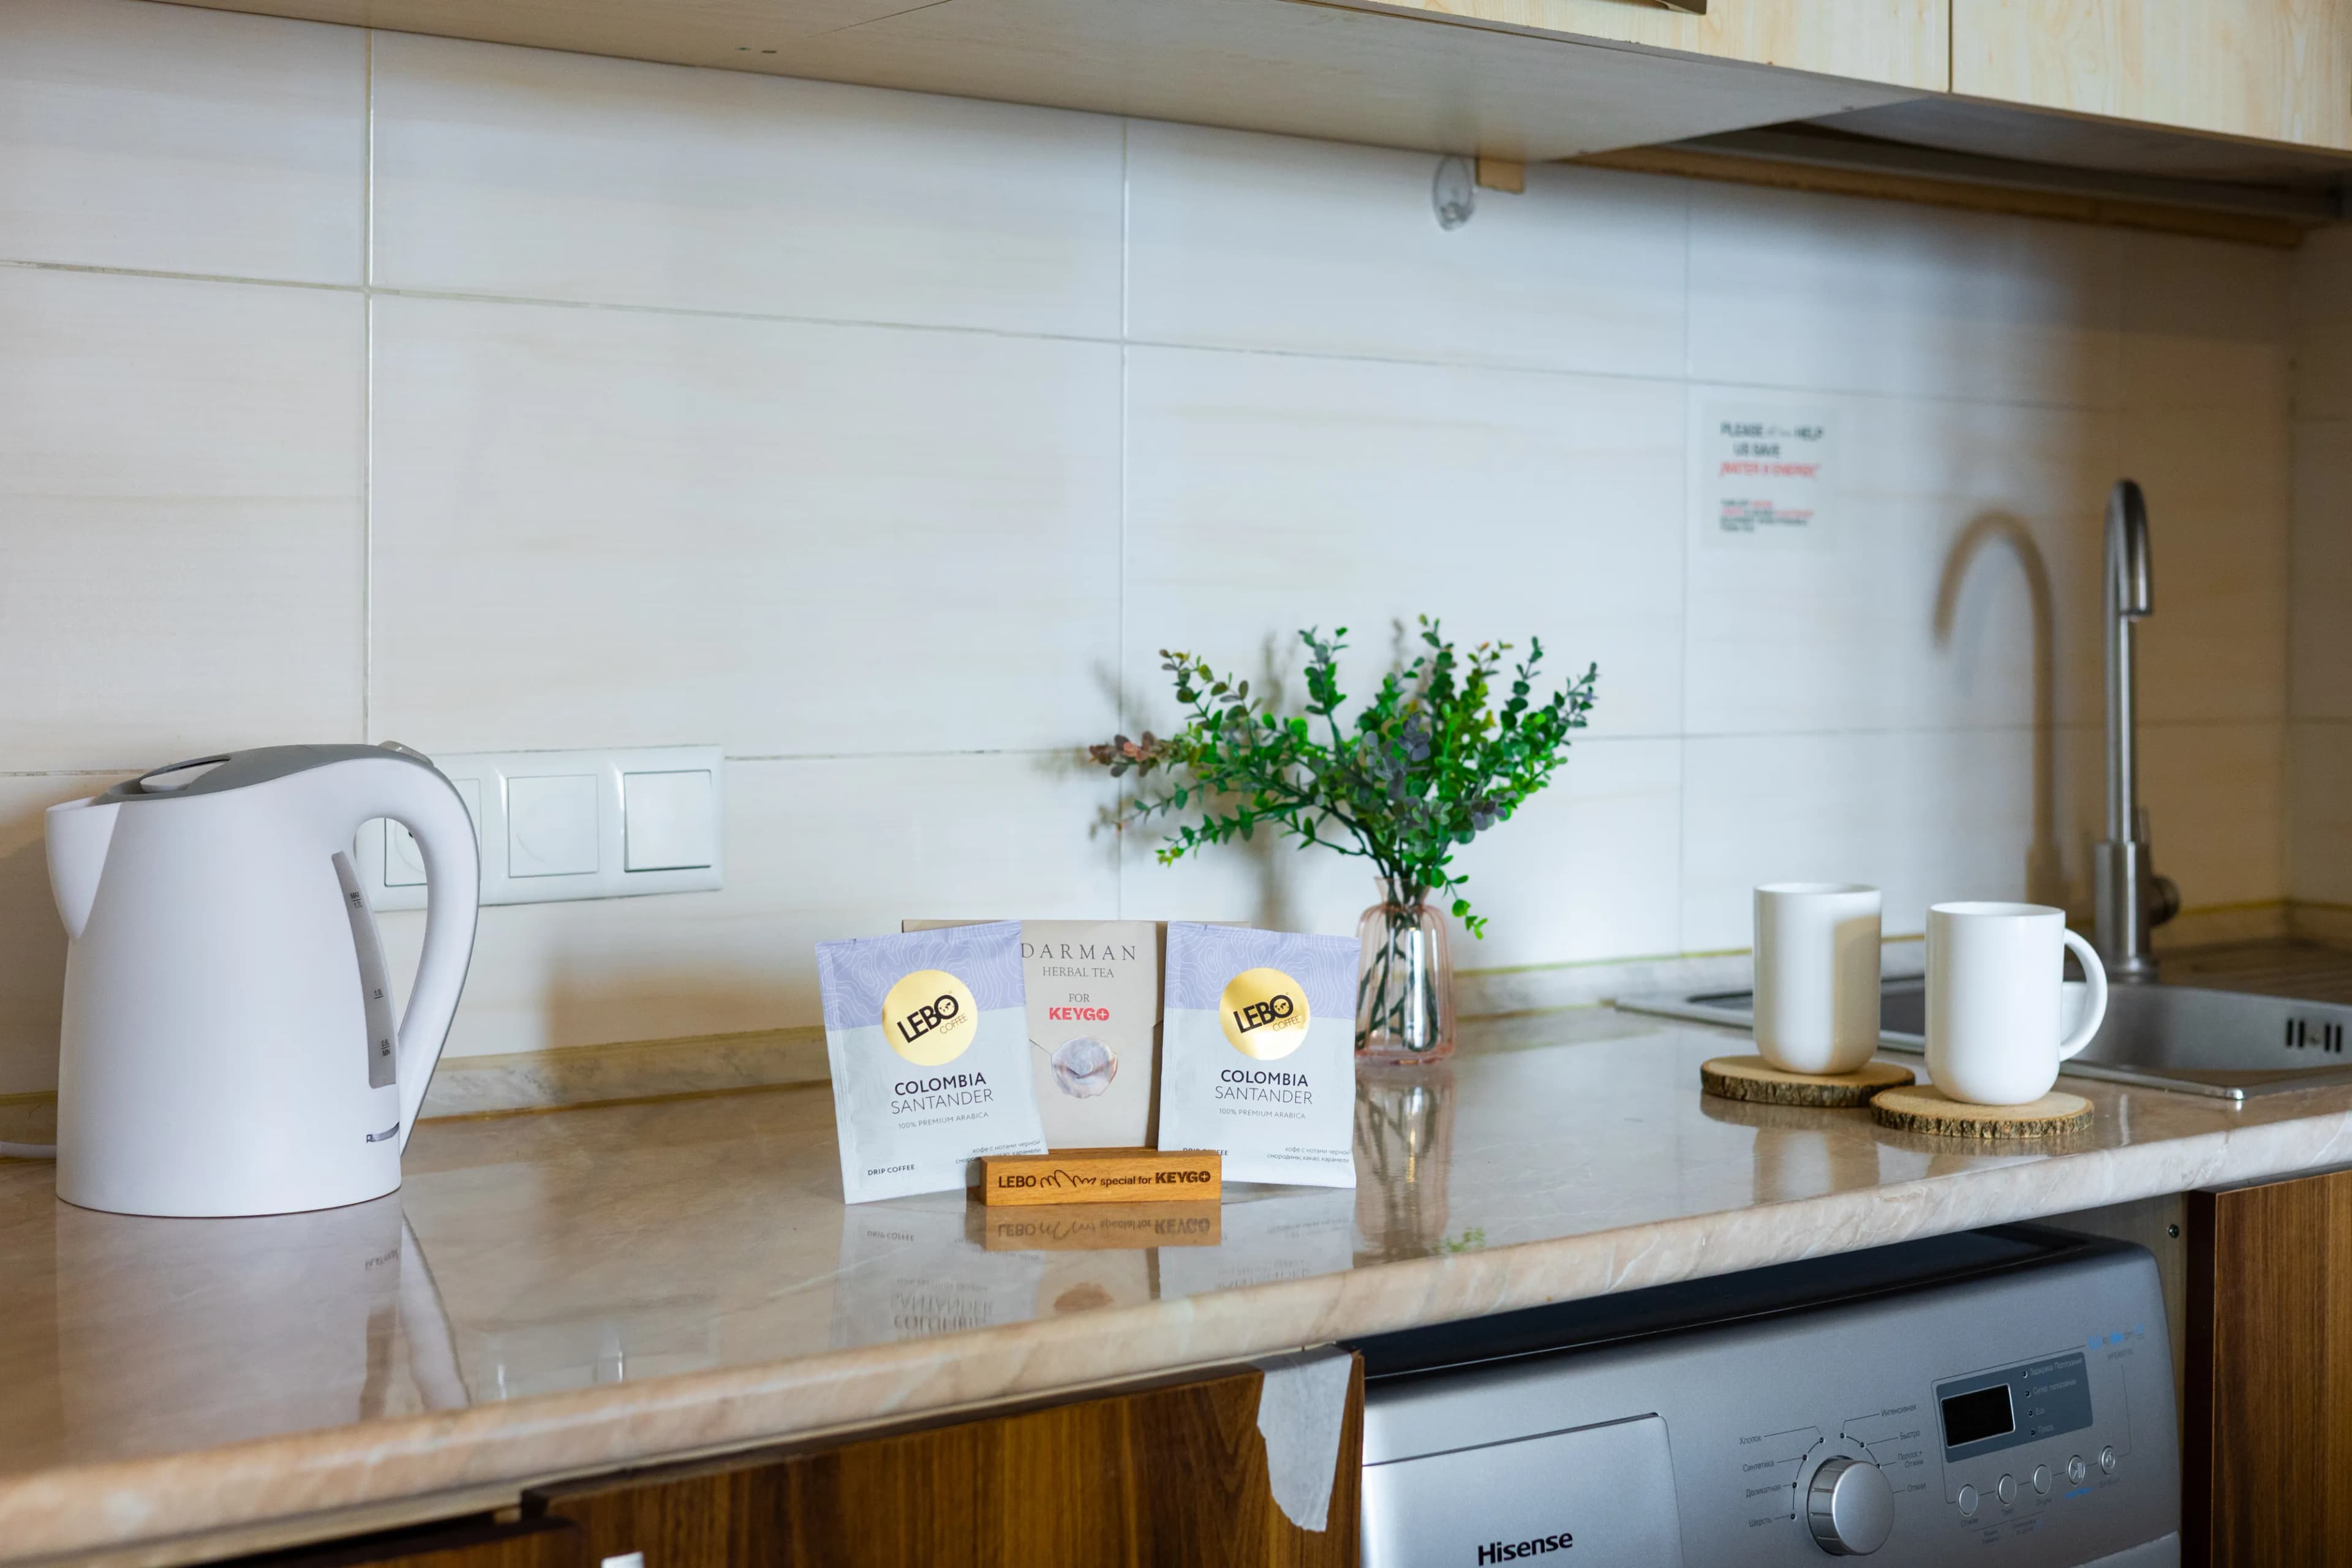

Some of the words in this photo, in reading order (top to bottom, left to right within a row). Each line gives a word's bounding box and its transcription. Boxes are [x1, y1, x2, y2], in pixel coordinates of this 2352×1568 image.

[1020, 942, 1136, 961] DARMAN
[1042, 966, 1088, 977] HERBAL
[1092, 967, 1114, 978] TEA
[1068, 993, 1090, 1003] FOR
[897, 994, 959, 1044] LEBO
[1049, 1007, 1110, 1021] KEYGO
[1233, 994, 1294, 1034] LEBO
[1273, 1015, 1301, 1031] COFFEE
[940, 1013, 968, 1034] COFFEE
[895, 1072, 987, 1096] COLOMBIA
[1221, 1069, 1308, 1087] COLOMBIA
[891, 1088, 993, 1114] SANTANDER
[1215, 1085, 1313, 1104] SANTANDER
[899, 1121, 917, 1129] 100%
[919, 1117, 954, 1126] PREMIUM
[956, 1112, 989, 1121] ARABICA
[887, 1164, 915, 1174] COFFEE
[998, 1175, 1036, 1188] LEBO
[1101, 1176, 1136, 1187] special
[1138, 1175, 1152, 1185] for
[1155, 1170, 1211, 1184] KEYGO
[1743, 1460, 1774, 1472] Синтетика
[1746, 1485, 1781, 1498] Деликатная
[1478, 1532, 1573, 1566] Hisense
